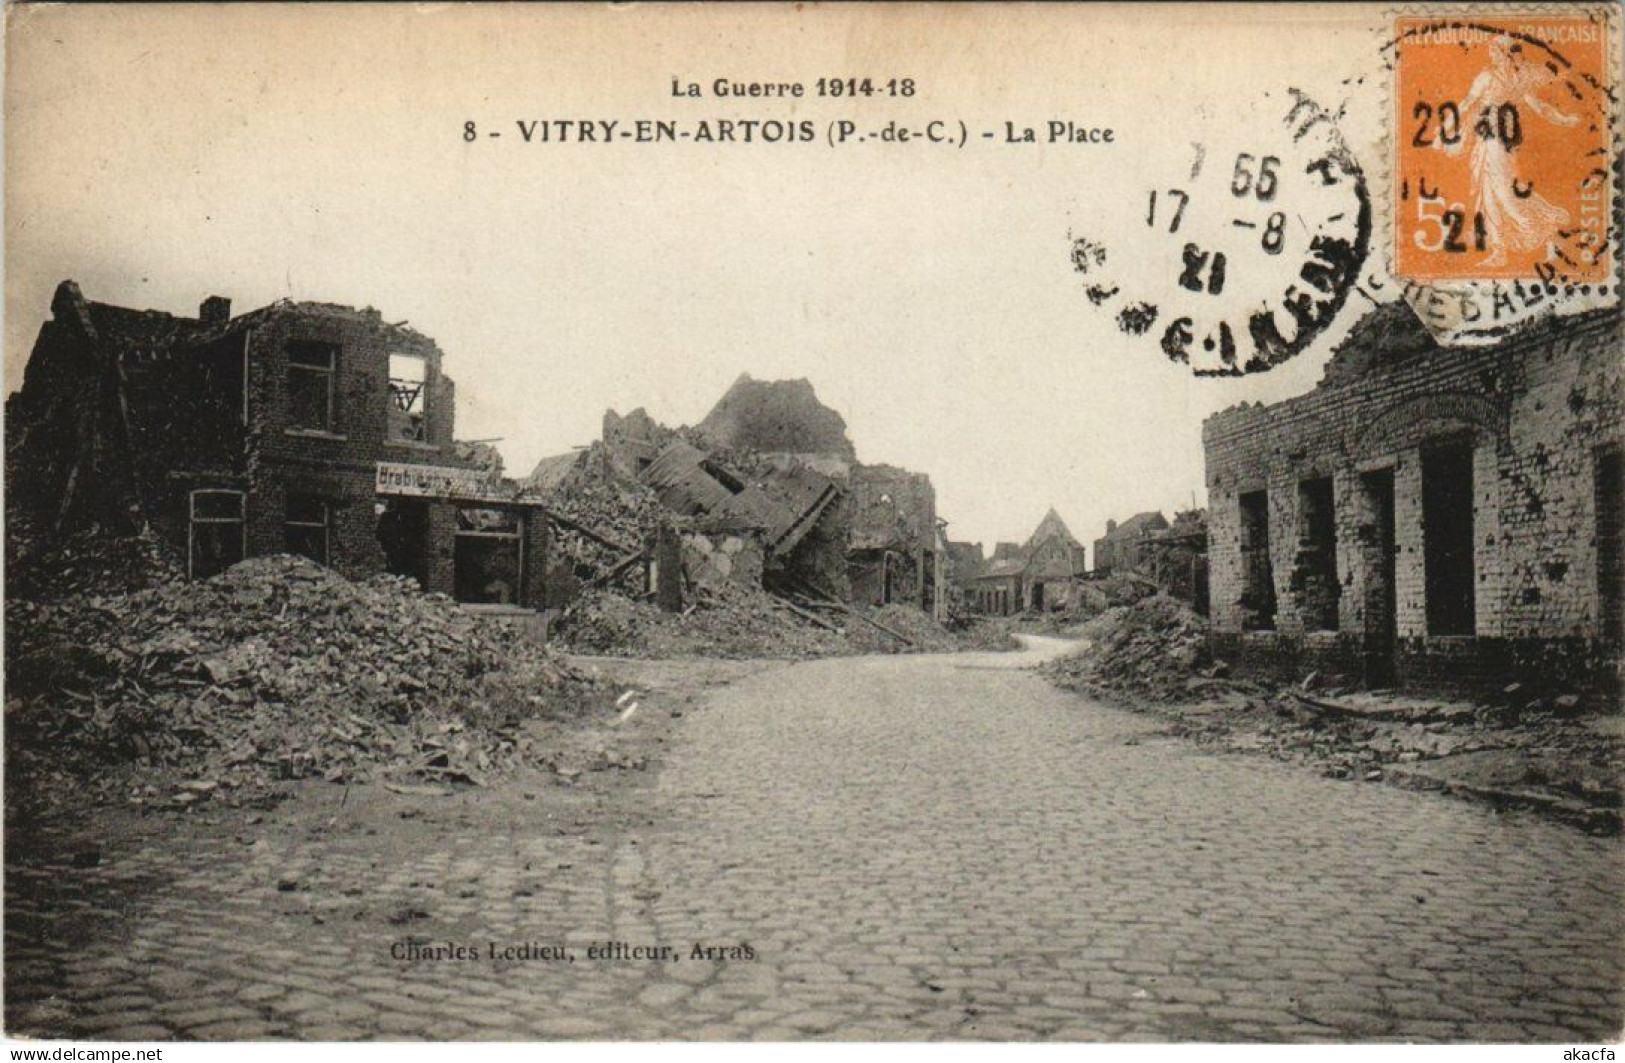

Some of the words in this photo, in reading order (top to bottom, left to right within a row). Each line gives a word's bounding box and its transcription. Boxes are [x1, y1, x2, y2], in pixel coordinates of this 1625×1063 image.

[671, 78, 701, 98] La
[713, 78, 804, 98] Guerre
[816, 78, 916, 98] 1914-18
[463, 120, 477, 142] 8
[516, 120, 815, 143] VITRY-EN-ARTOIS
[827, 119, 968, 148] (P.-de-C.)
[1005, 121, 1036, 143] La
[1048, 120, 1115, 143] Place
[1412, 101, 1462, 147] 20
[1146, 189, 1190, 234] 17
[1442, 210, 1488, 252] 21
[390, 939, 479, 962] Charles
[689, 942, 755, 961] Arras
